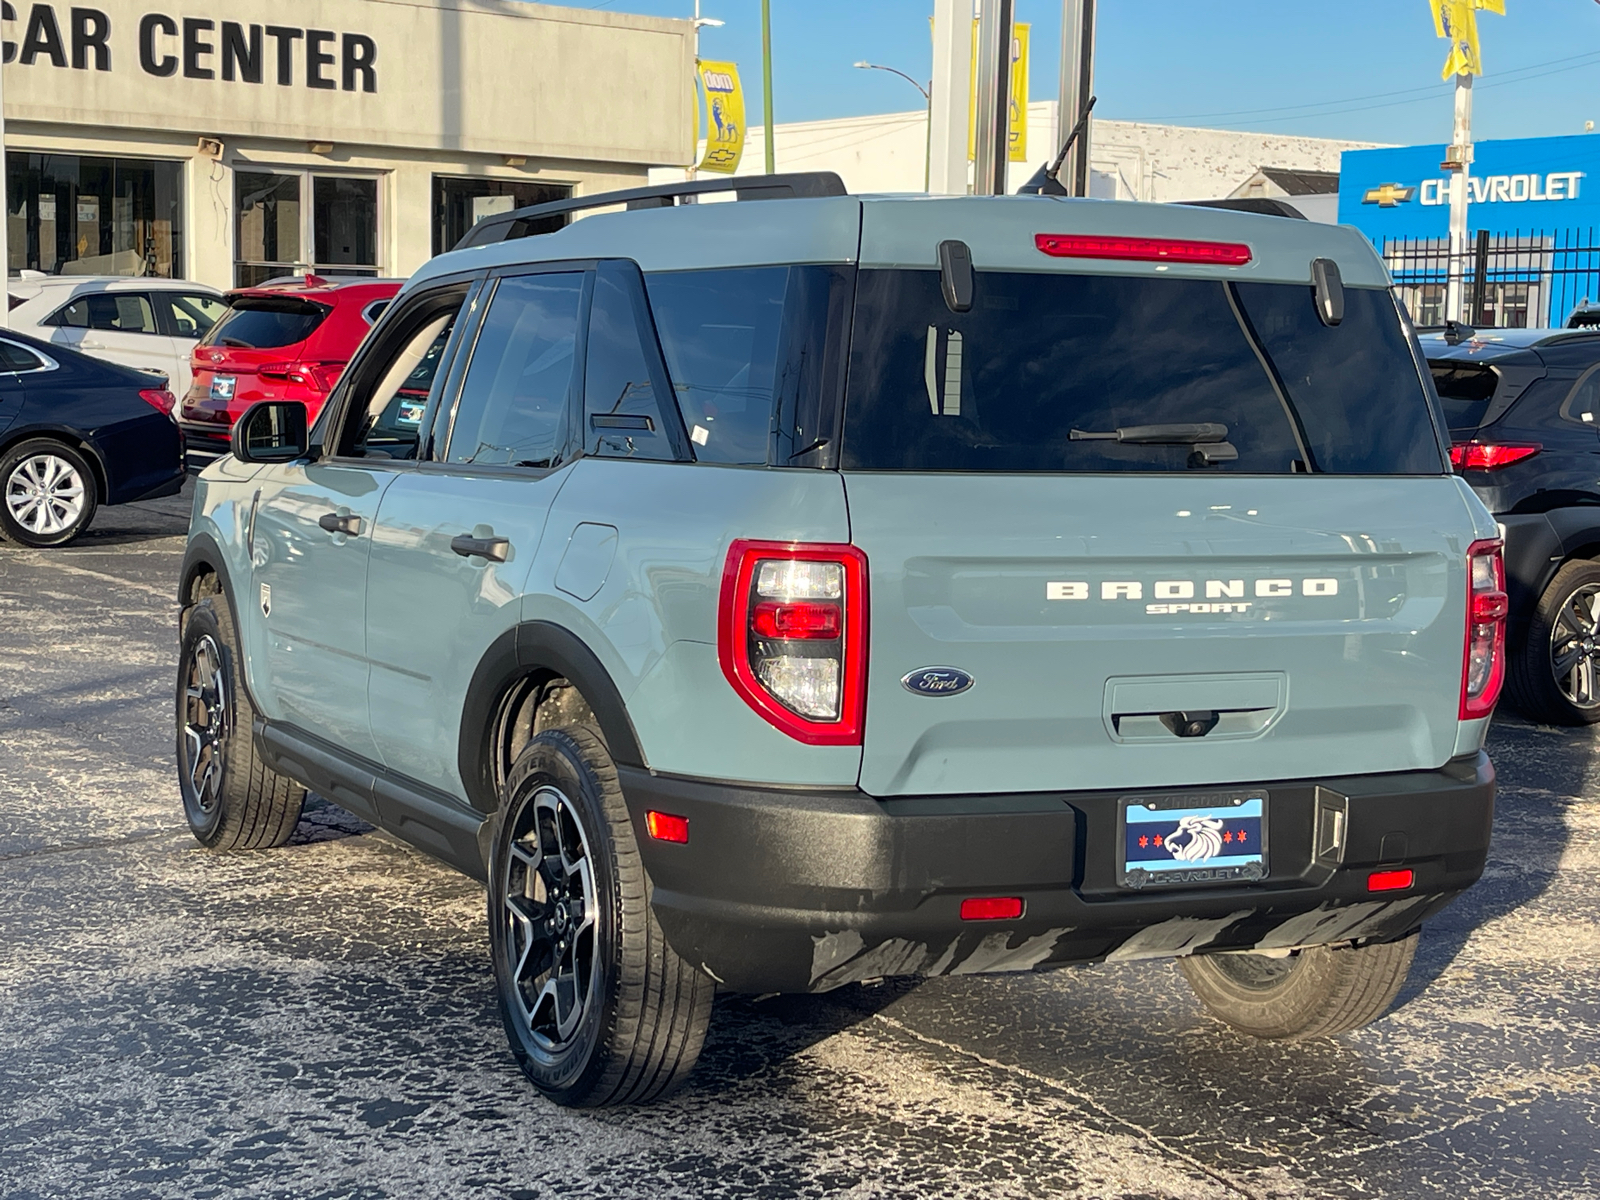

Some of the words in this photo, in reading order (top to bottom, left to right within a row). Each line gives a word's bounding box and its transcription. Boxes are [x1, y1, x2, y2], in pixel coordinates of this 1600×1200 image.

[139, 13, 377, 93] CENTER
[704, 70, 734, 92] dom
[1046, 578, 1338, 600] BRONCO
[1145, 603, 1252, 614] SPORT
[919, 672, 959, 690] Ford
[1155, 869, 1234, 883] CHEVROLET
